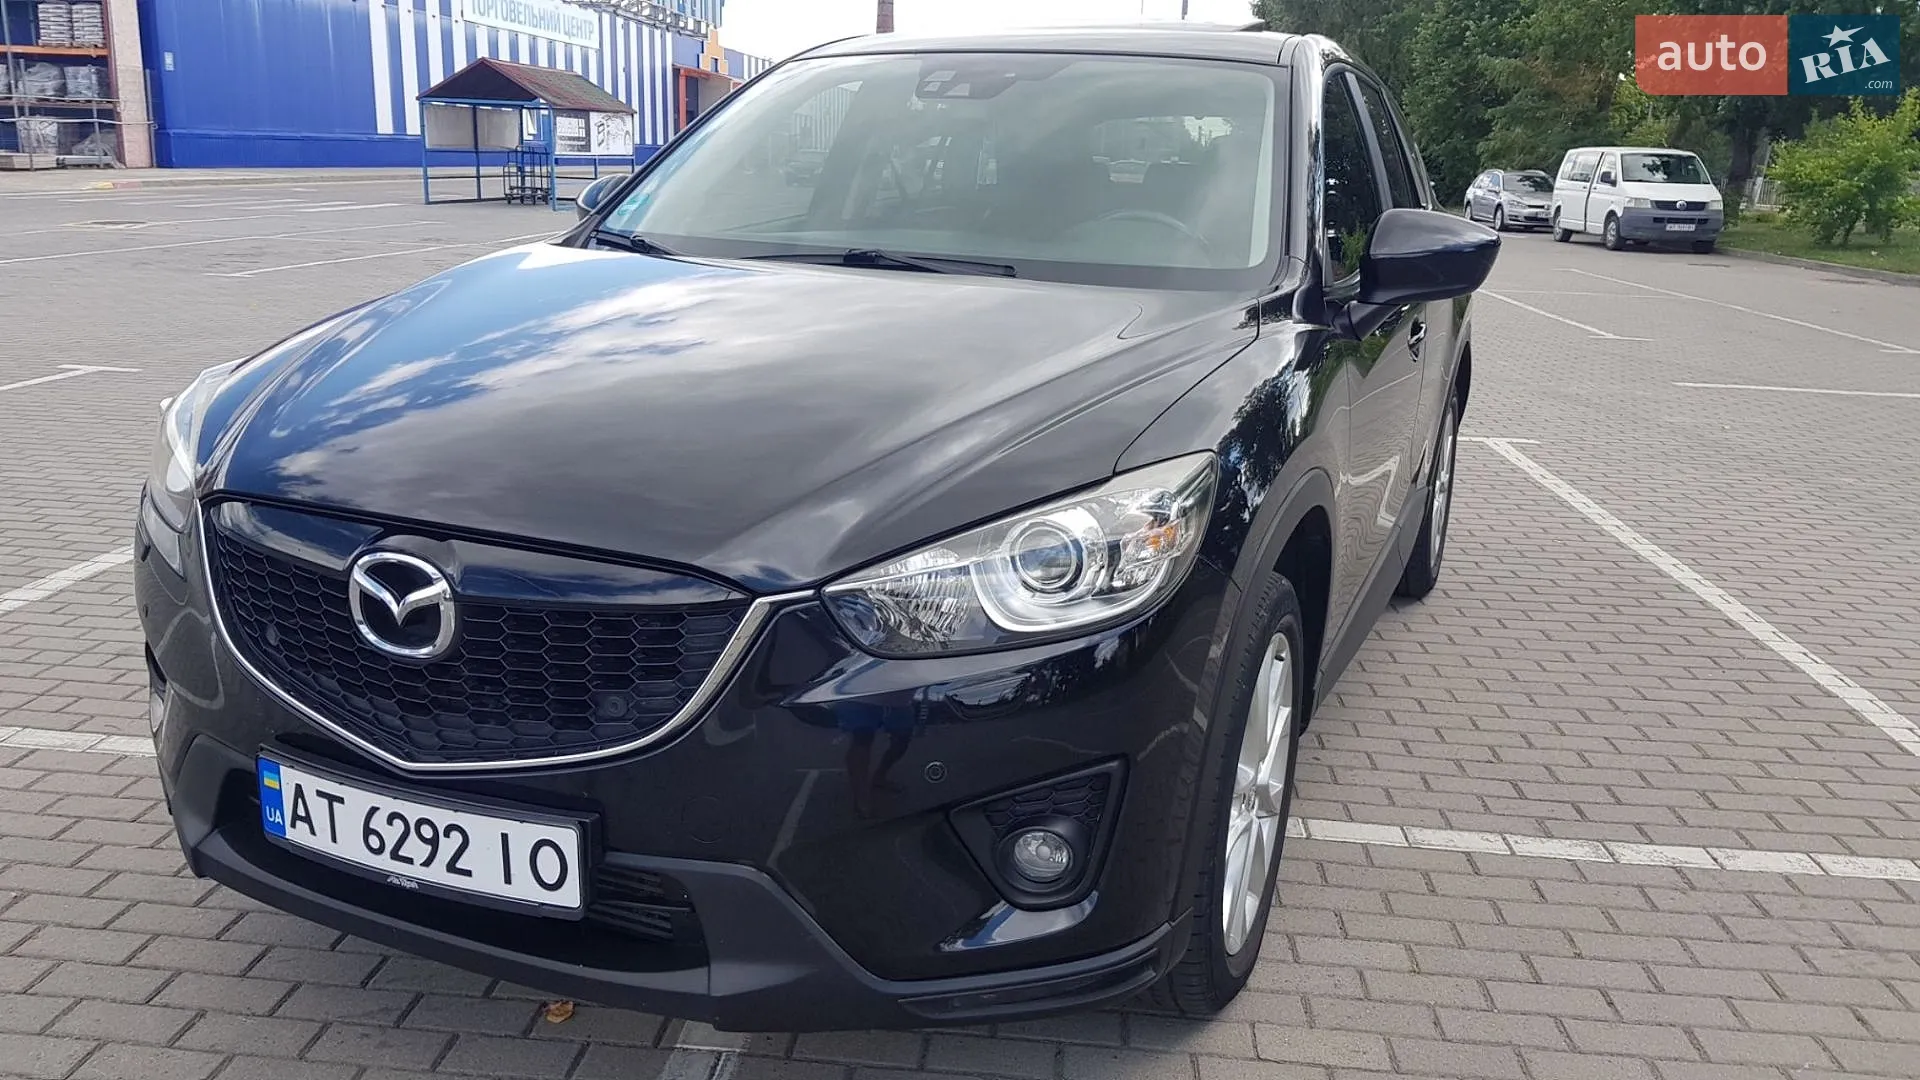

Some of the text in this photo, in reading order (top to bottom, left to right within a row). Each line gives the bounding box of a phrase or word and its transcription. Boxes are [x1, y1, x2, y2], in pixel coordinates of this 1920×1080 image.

[563, 13, 595, 41] ЦЕНТР
[266, 804, 283, 826] UA
[290, 782, 568, 891] AT 6292 IO
